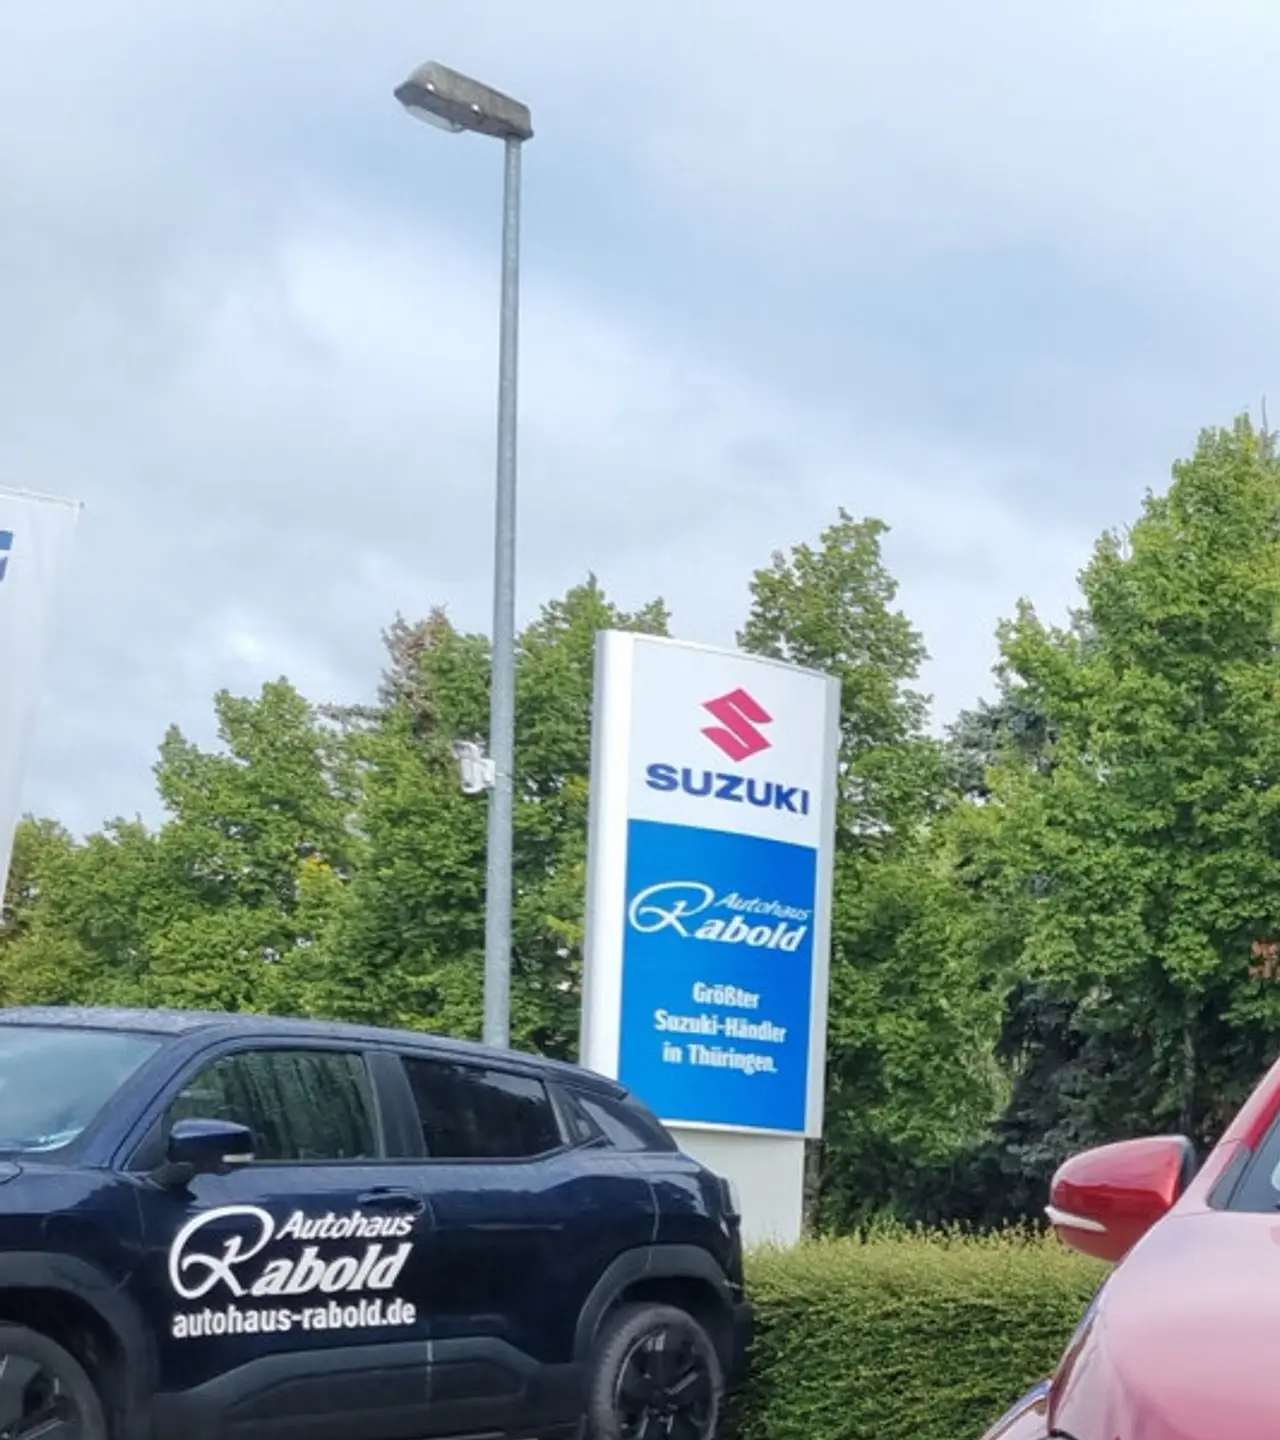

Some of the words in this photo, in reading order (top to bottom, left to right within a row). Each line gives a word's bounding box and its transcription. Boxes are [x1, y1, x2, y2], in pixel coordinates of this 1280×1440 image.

[645, 762, 810, 815] SUZUKI
[629, 881, 808, 951] Rabold
[714, 891, 812, 920] Autohaus
[692, 981, 760, 1009] Größter
[654, 1009, 787, 1042] Suzuki-Händler
[663, 1042, 682, 1063] in
[688, 1044, 778, 1075] Thüringen.
[275, 1210, 416, 1240] Autohaus
[168, 1205, 414, 1300] Rabold
[172, 1297, 416, 1338] autohaus-rabold.de
